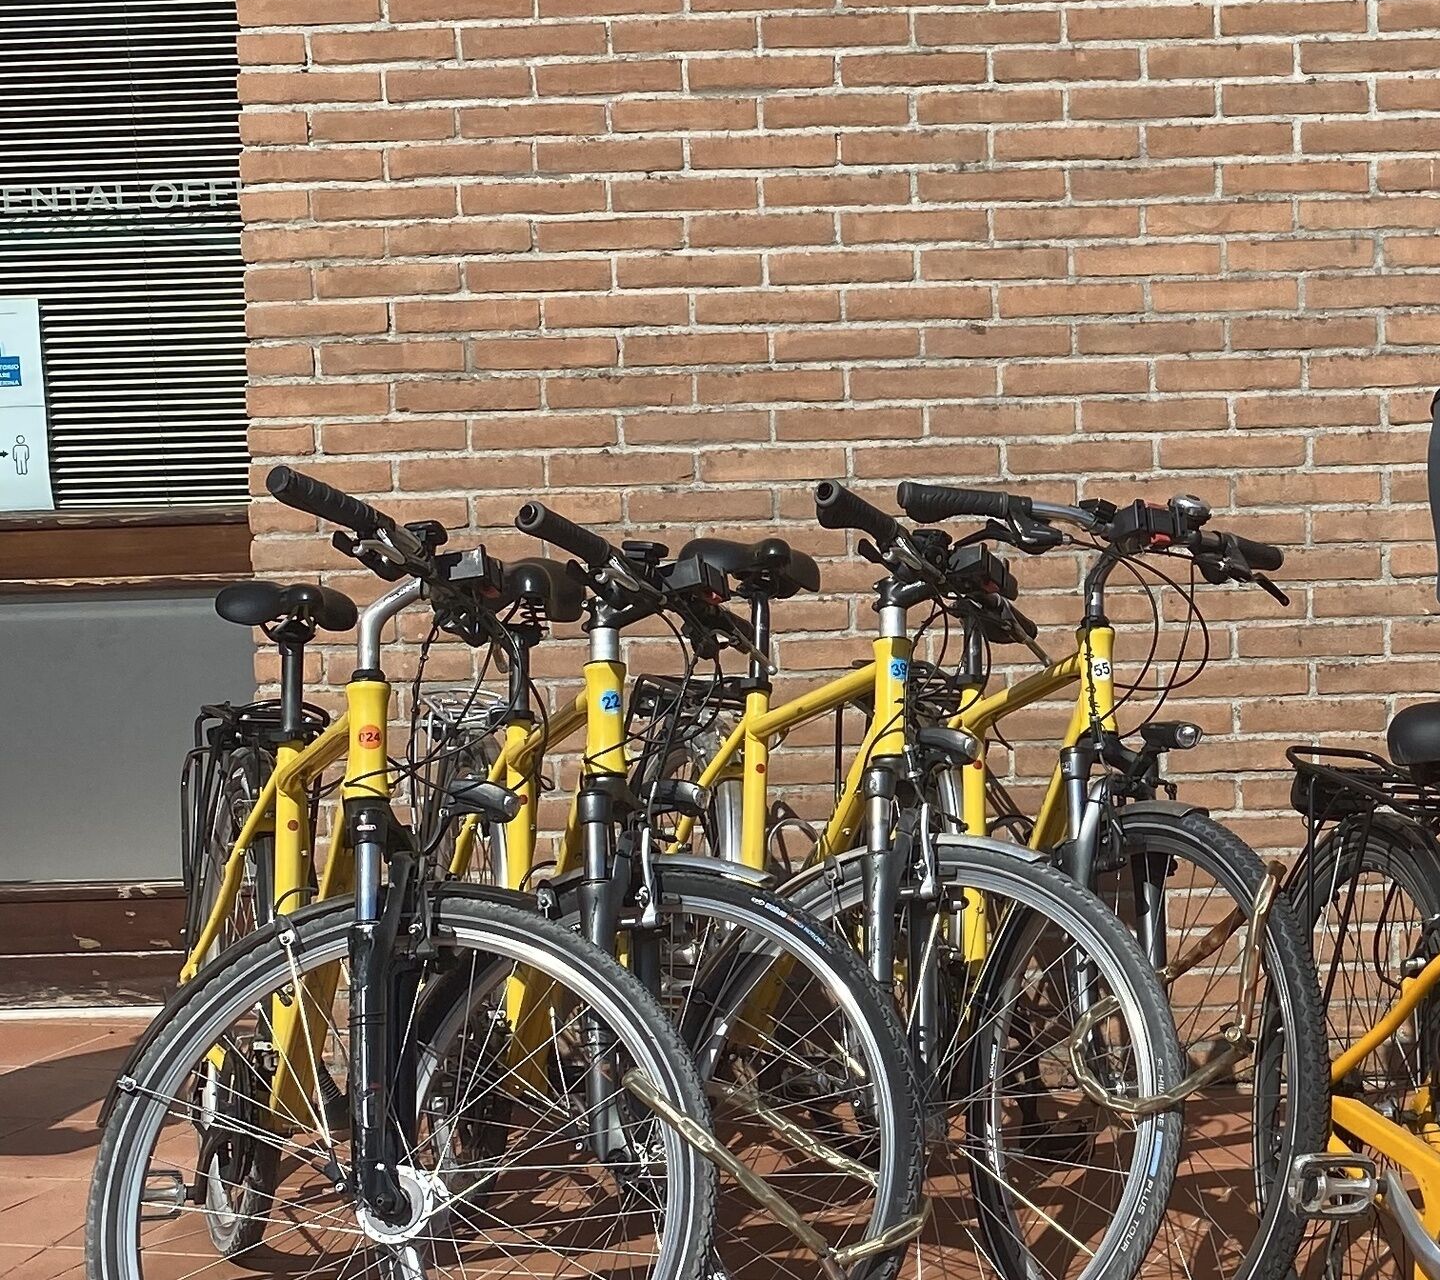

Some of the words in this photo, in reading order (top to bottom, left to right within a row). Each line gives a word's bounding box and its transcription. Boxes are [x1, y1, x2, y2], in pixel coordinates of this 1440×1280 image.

[891, 662, 907, 677] 39
[1094, 662, 1110, 677] 55
[602, 693, 621, 711] 22
[1137, 1178, 1155, 1216] PLUS
[1120, 1218, 1141, 1254] TOUR
